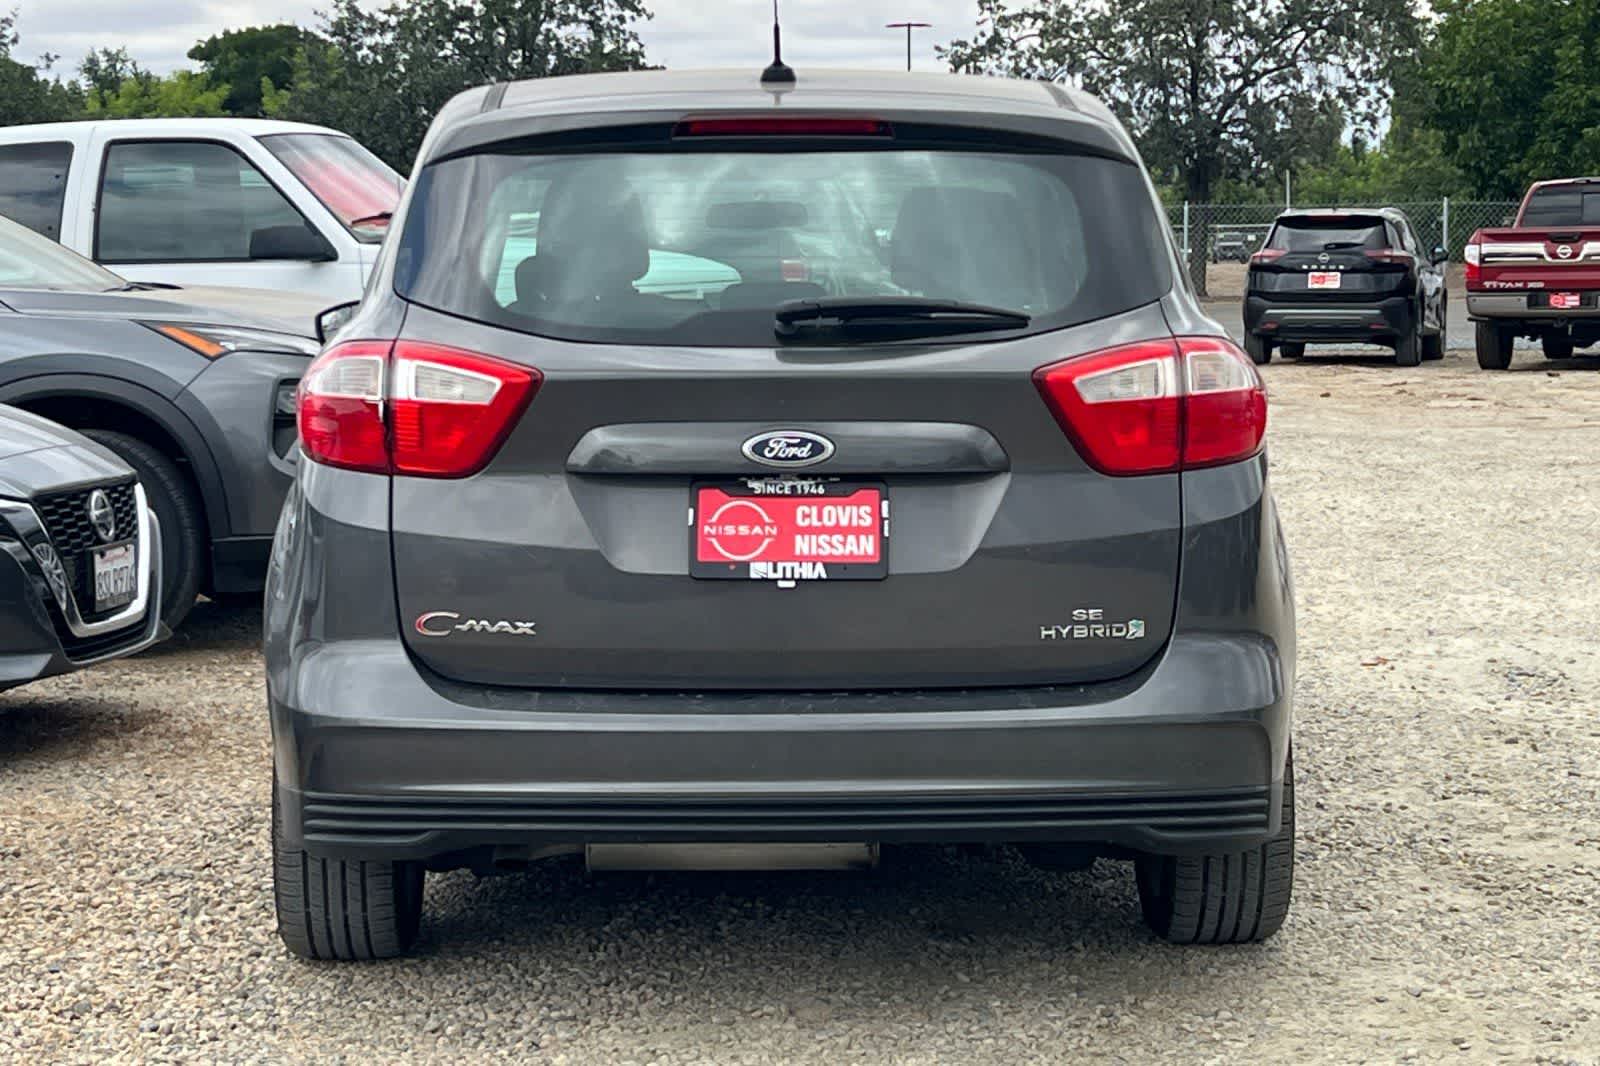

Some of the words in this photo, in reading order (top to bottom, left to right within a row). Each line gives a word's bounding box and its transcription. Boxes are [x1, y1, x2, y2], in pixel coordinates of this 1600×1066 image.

[764, 437, 813, 458] Ford
[753, 483, 792, 495] SINCE
[796, 483, 825, 495] 1946
[795, 504, 873, 527] CLOVIS
[703, 524, 778, 536] NISSAN
[794, 534, 875, 556] NISSAN
[1071, 608, 1104, 621] SE
[1040, 623, 1128, 640] HYBRID
